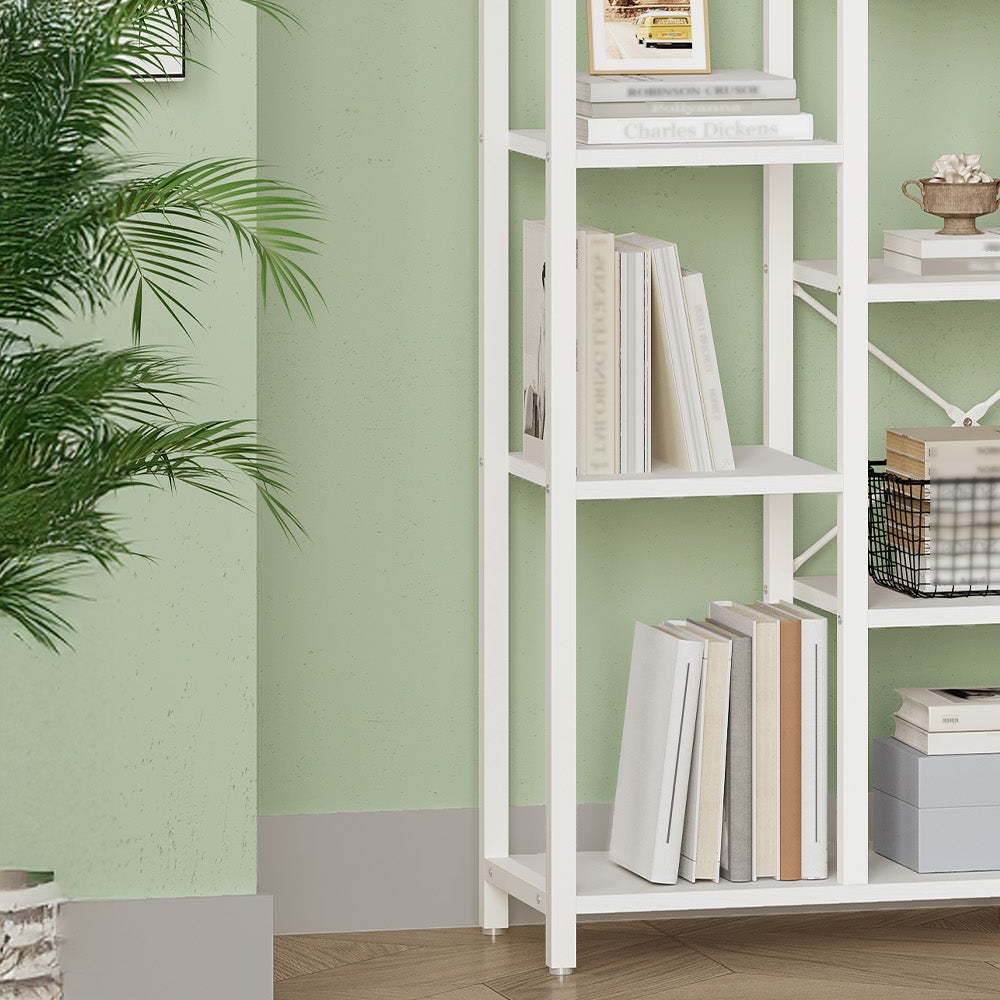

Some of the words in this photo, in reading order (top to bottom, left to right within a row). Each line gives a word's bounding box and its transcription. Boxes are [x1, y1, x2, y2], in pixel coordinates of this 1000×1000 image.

[627, 87, 701, 98] ROBINSON
[623, 121, 697, 140] Charles
[703, 120, 780, 138] Dickens
